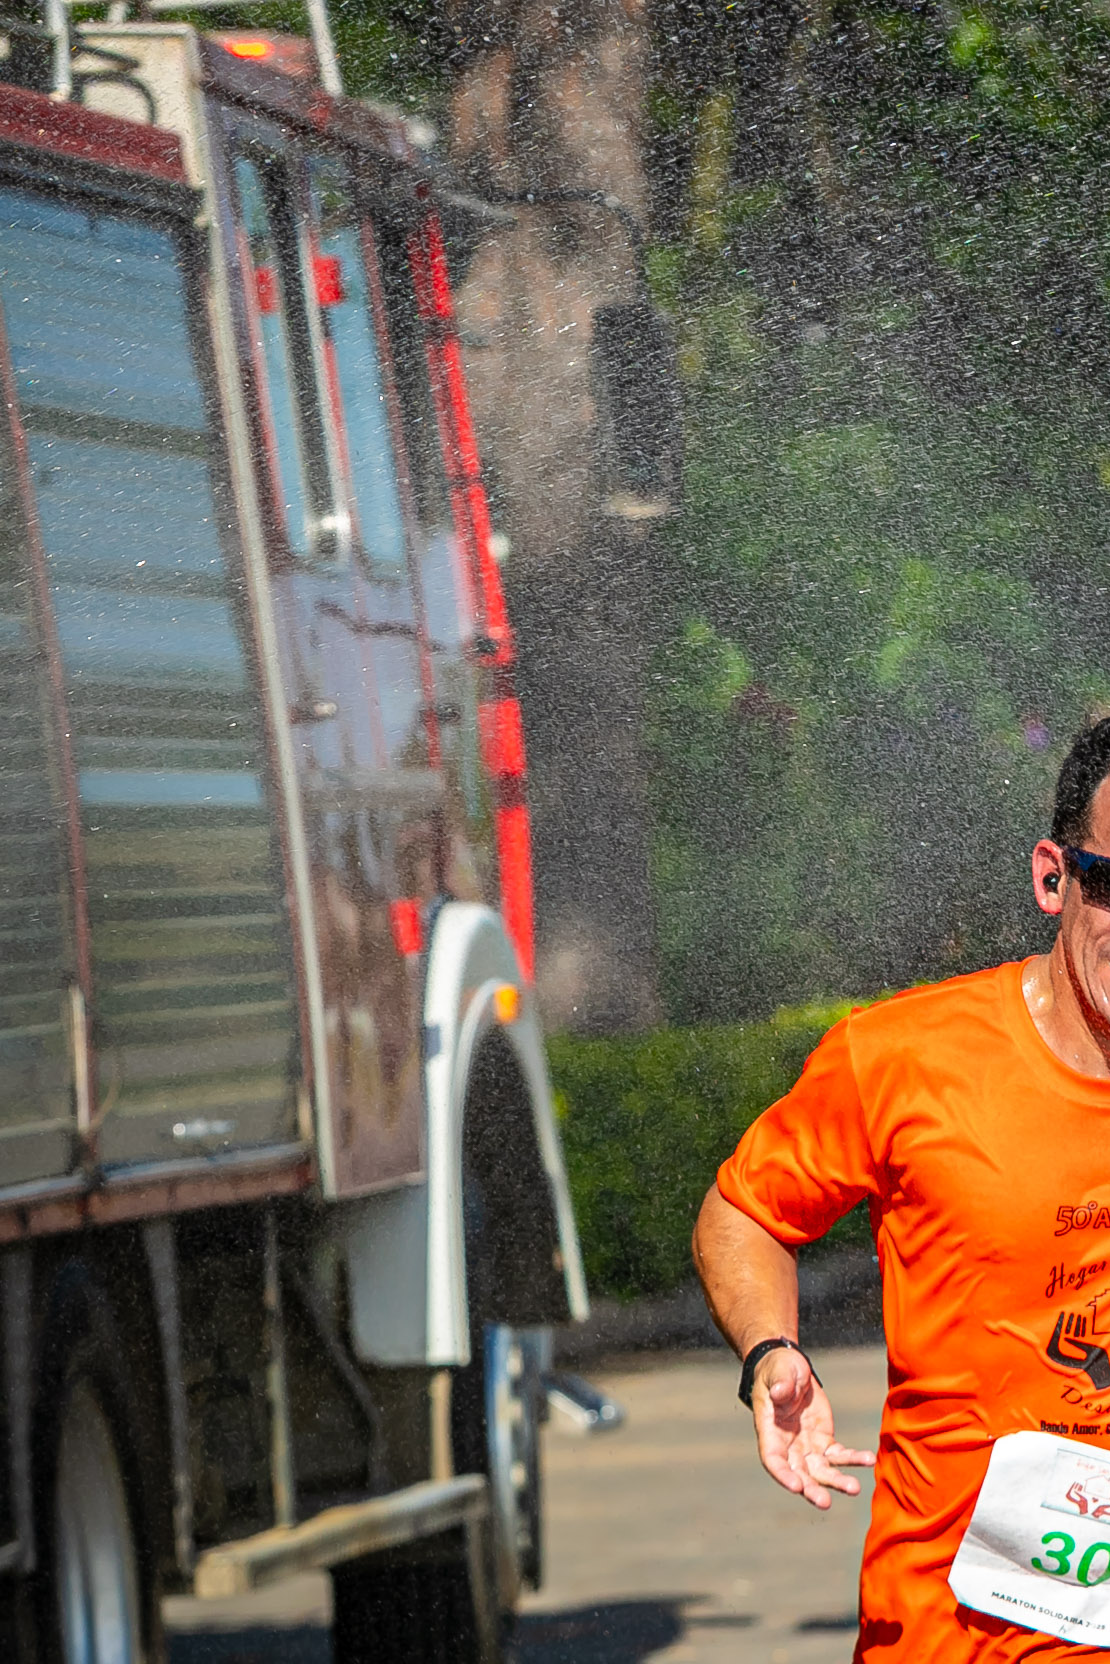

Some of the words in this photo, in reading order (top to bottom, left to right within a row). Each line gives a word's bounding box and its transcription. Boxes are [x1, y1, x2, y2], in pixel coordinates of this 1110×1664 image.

[1045, 1261, 1107, 1298] Hogar
[991, 1591, 1037, 1610] MARATON
[1038, 1606, 1084, 1626] SOLIDARIA
